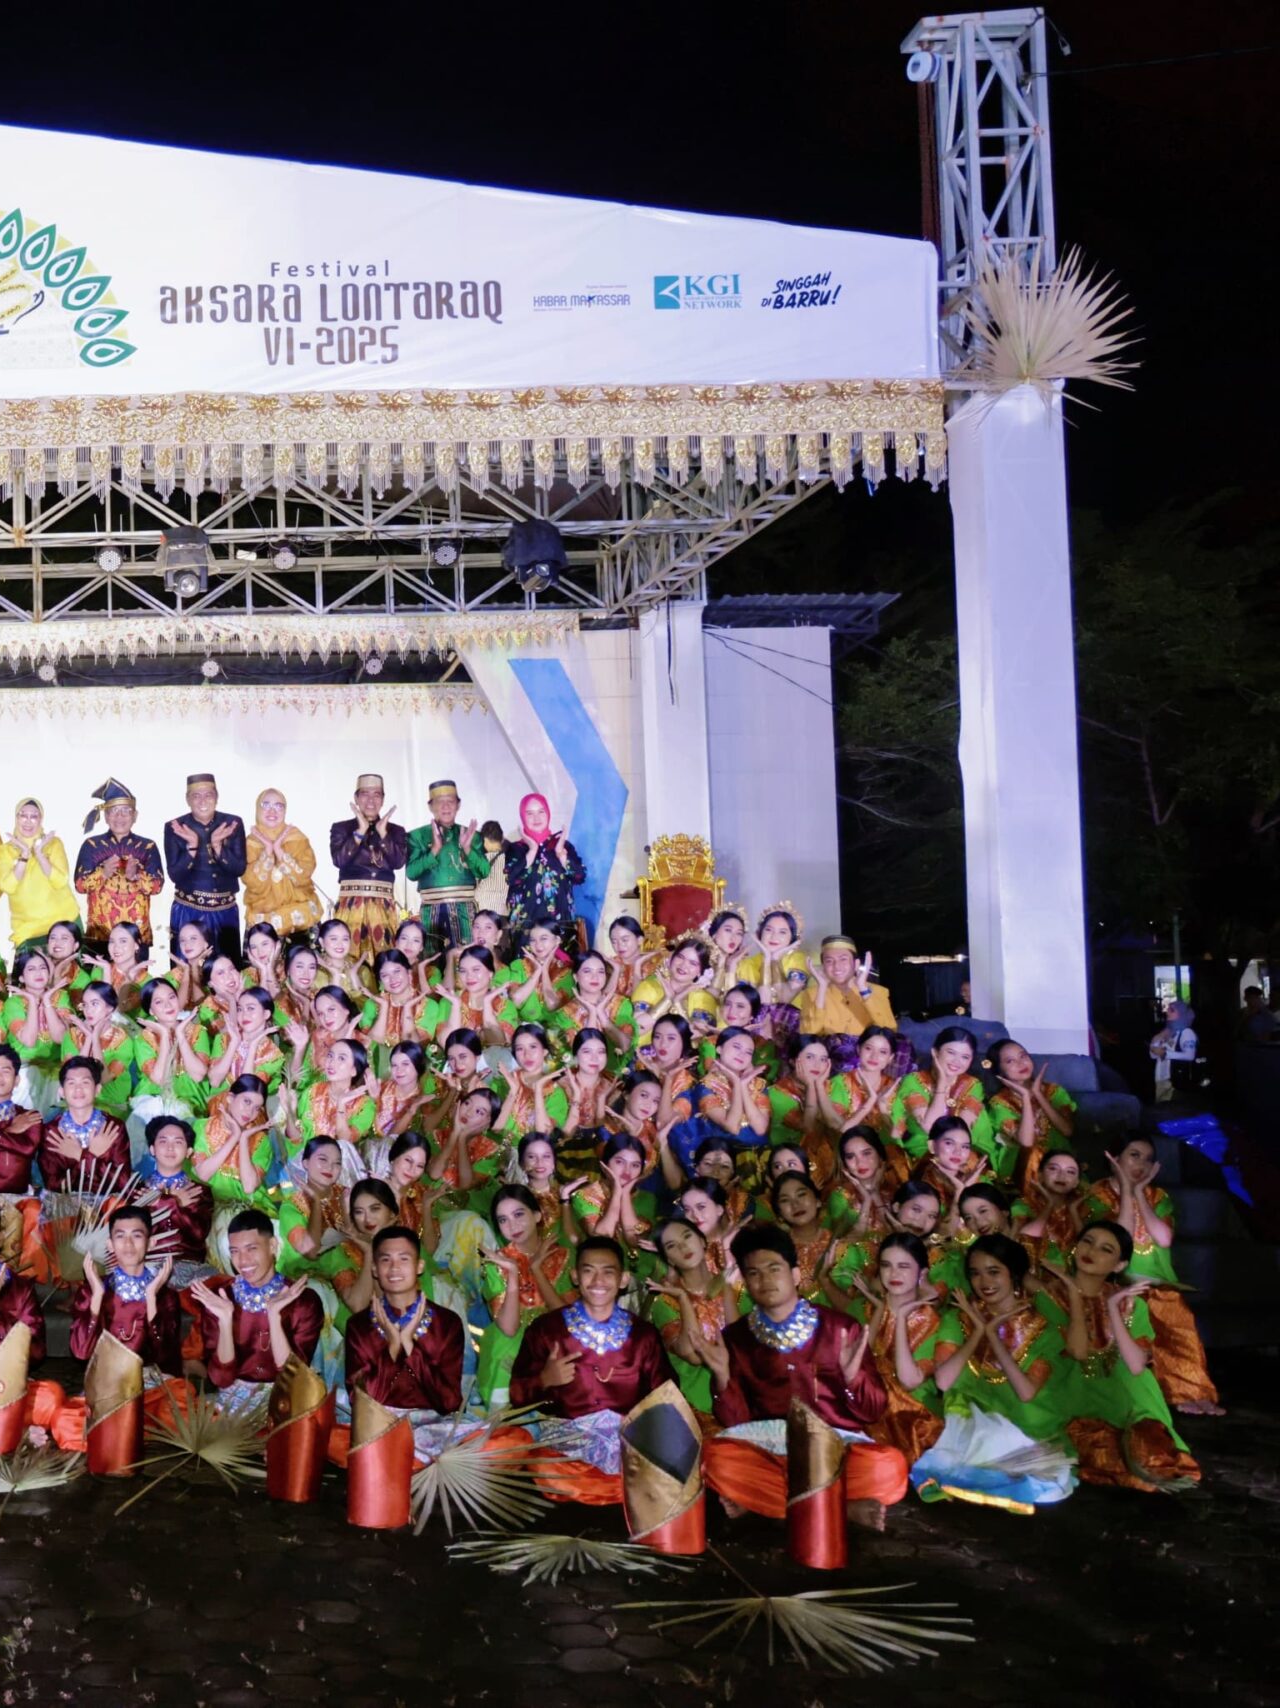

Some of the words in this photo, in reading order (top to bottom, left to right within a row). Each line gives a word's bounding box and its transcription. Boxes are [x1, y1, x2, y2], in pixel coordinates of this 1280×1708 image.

[270, 260, 390, 277] Festival
[683, 273, 741, 296] KGI
[772, 271, 832, 294] SINGGAH
[683, 299, 742, 311] NETWORK
[761, 298, 772, 308] DI
[772, 284, 842, 310] BARRU!
[263, 326, 399, 366] VI-2025
